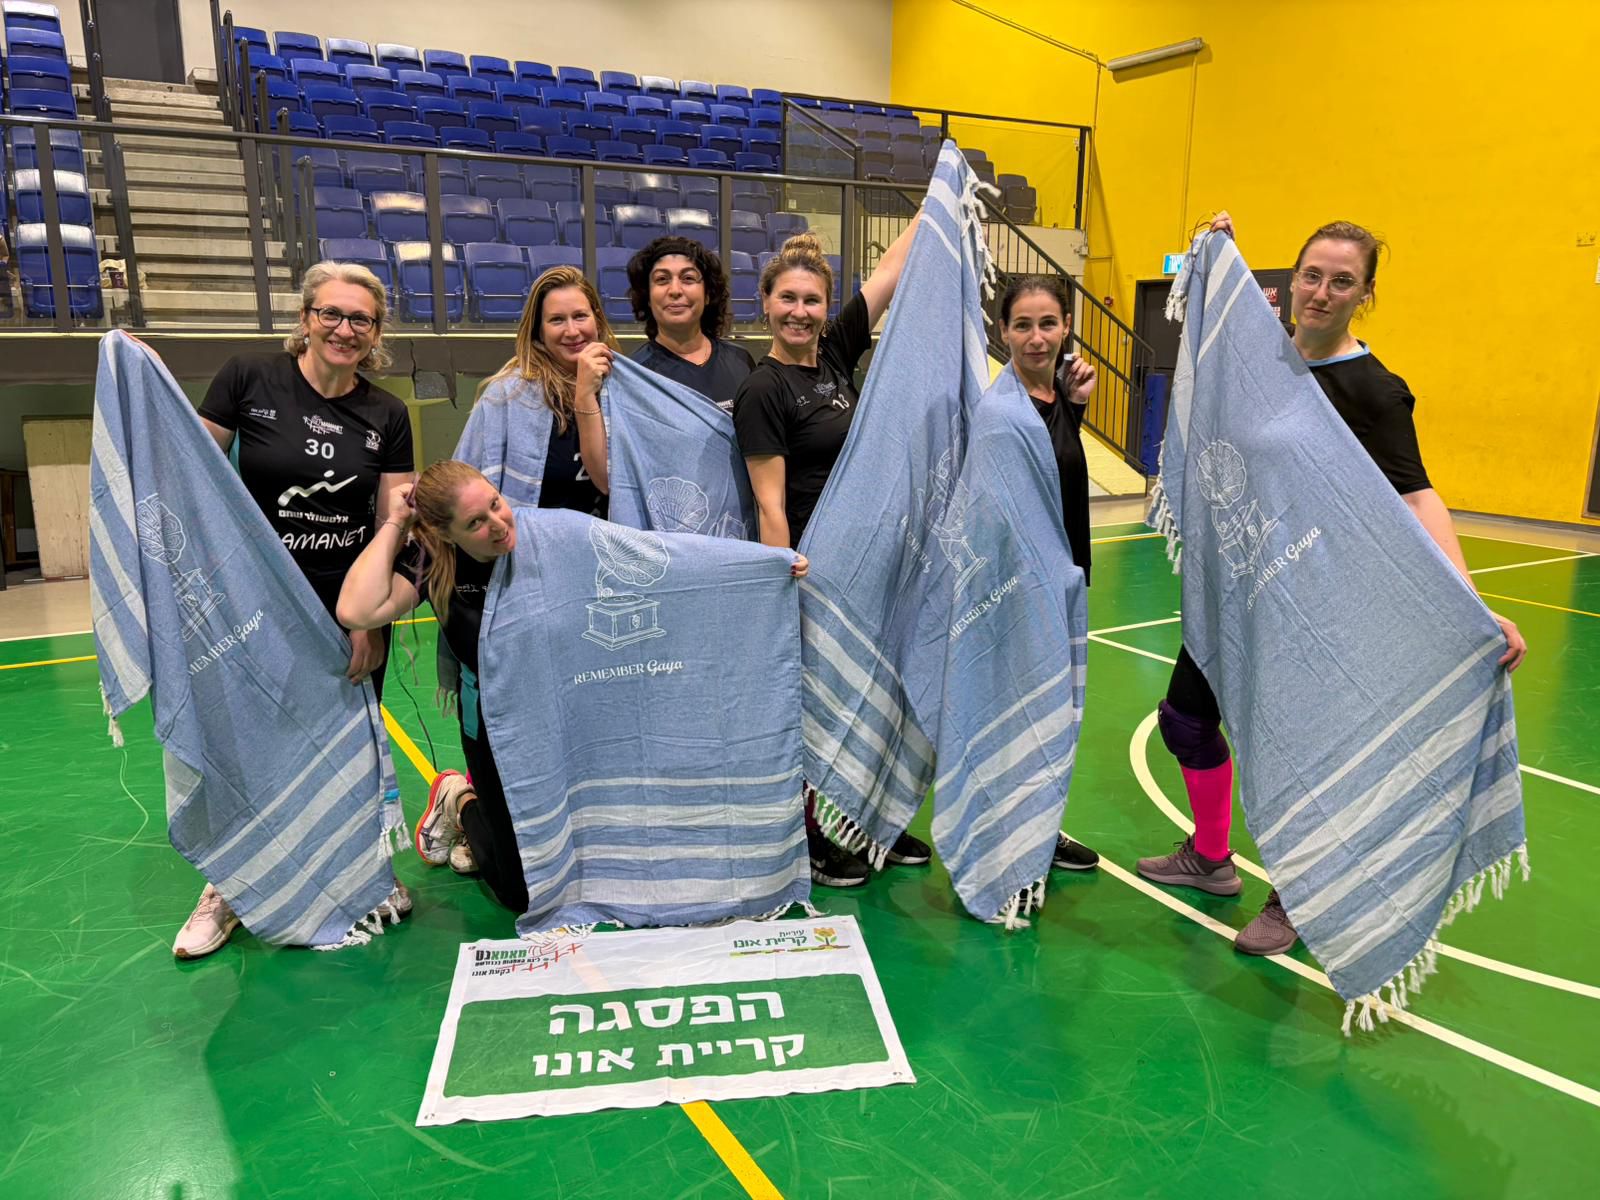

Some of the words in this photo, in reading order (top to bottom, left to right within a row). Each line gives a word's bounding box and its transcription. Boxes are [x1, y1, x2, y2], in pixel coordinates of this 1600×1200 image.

[832, 393, 850, 410] 13
[304, 438, 335, 460] 30
[276, 525, 367, 550] AMANET
[1284, 525, 1322, 561] Gaya
[949, 599, 992, 642] MEMBER
[187, 634, 238, 676] MEMBER
[232, 608, 264, 643] Gaya
[574, 663, 645, 685] REMEMBER
[646, 659, 684, 676] Gaya
[733, 938, 764, 948] אונו
[765, 935, 808, 947] קריית
[475, 949, 527, 961] מאמאנט
[549, 991, 785, 1035] הפסגה
[532, 1047, 635, 1077] אונו
[656, 1033, 805, 1067] קריית
